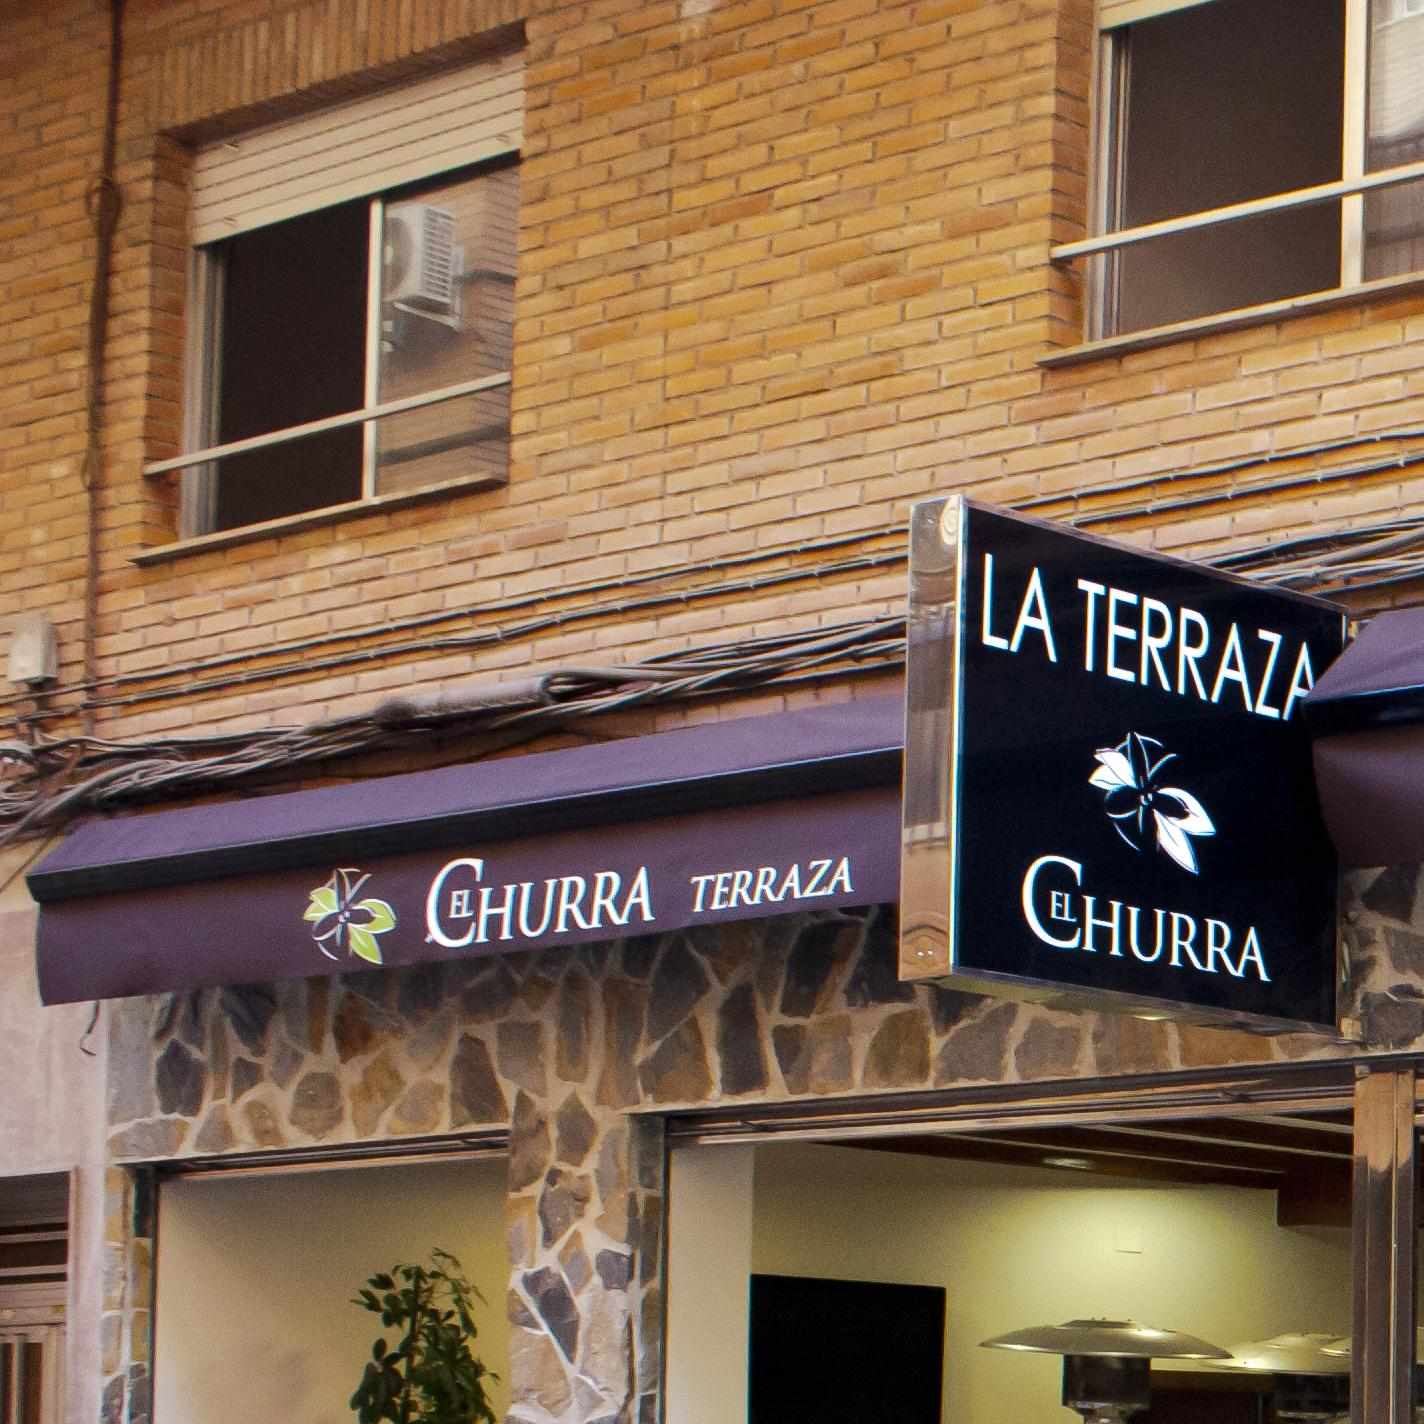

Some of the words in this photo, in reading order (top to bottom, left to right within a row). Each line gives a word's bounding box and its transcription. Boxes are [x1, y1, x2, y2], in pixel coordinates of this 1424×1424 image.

[983, 552, 1057, 662] LA
[1078, 578, 1315, 721] TERRAZA
[690, 856, 854, 913] TERRAZA
